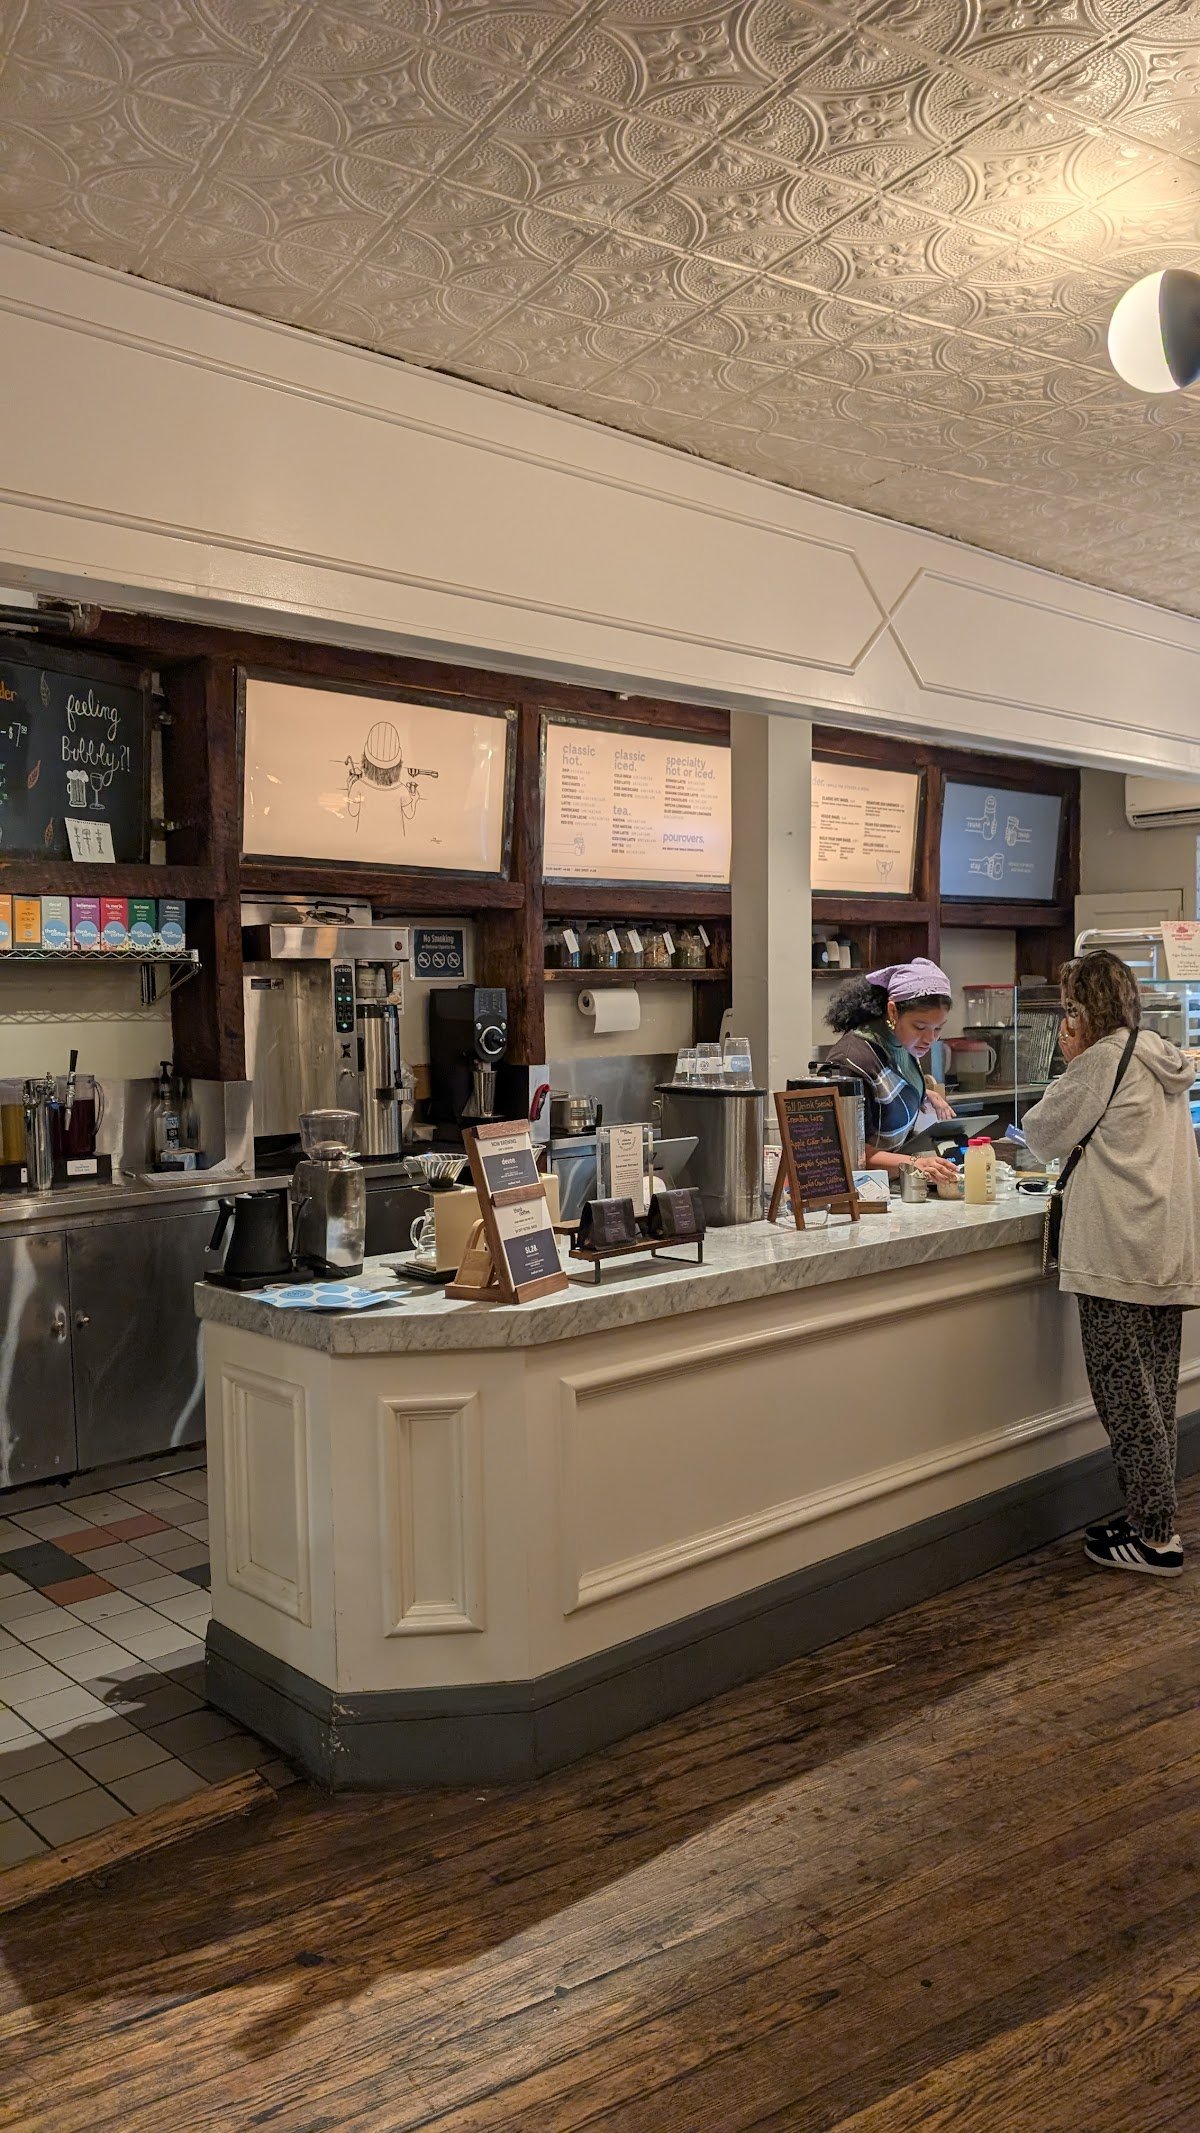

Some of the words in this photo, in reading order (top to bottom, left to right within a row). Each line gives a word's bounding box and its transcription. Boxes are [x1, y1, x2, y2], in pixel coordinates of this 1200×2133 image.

[66, 689, 121, 741] feeling
[562, 743, 596, 757] classic
[614, 749, 646, 762] classic
[562, 754, 583, 766] hot.
[614, 760, 637, 772] iced.
[666, 756, 706, 770] specialty
[666, 766, 680, 776] hot
[683, 768, 693, 777] or
[695, 768, 716, 780] iced.
[613, 804, 631, 816] tea.
[663, 833, 705, 844] pourovers.
[423, 934, 431, 943] No
[431, 934, 454, 944] Smoking
